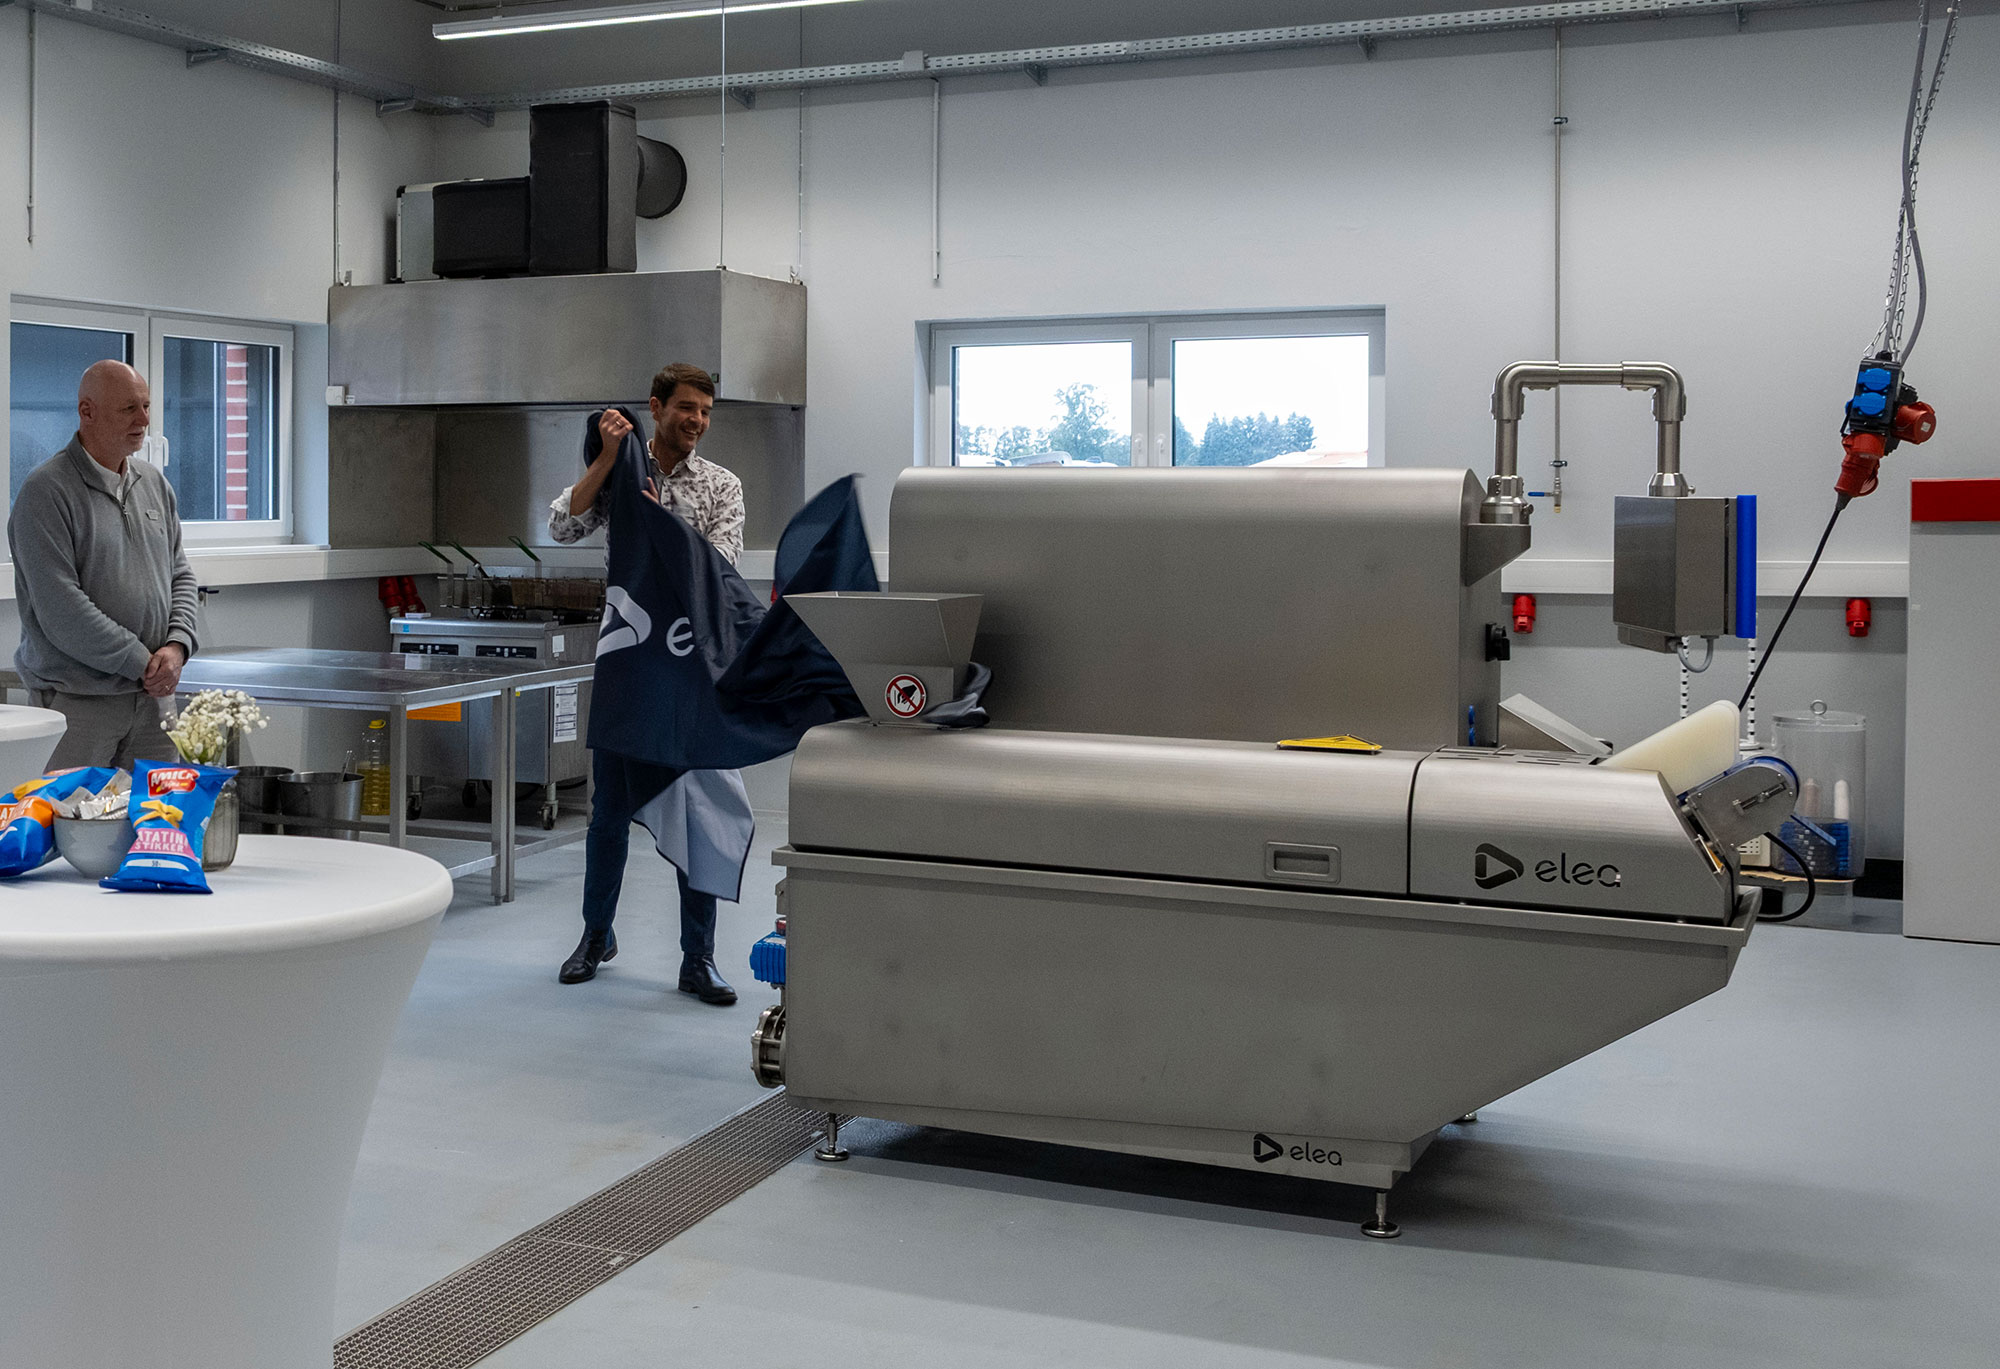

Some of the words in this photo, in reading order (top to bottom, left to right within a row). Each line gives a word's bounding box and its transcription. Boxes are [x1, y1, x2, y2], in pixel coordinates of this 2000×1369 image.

[135, 840, 185, 853] STIKKER
[136, 830, 189, 847] ATATIN
[1535, 852, 1621, 888] elea
[1290, 1141, 1342, 1166] elea
